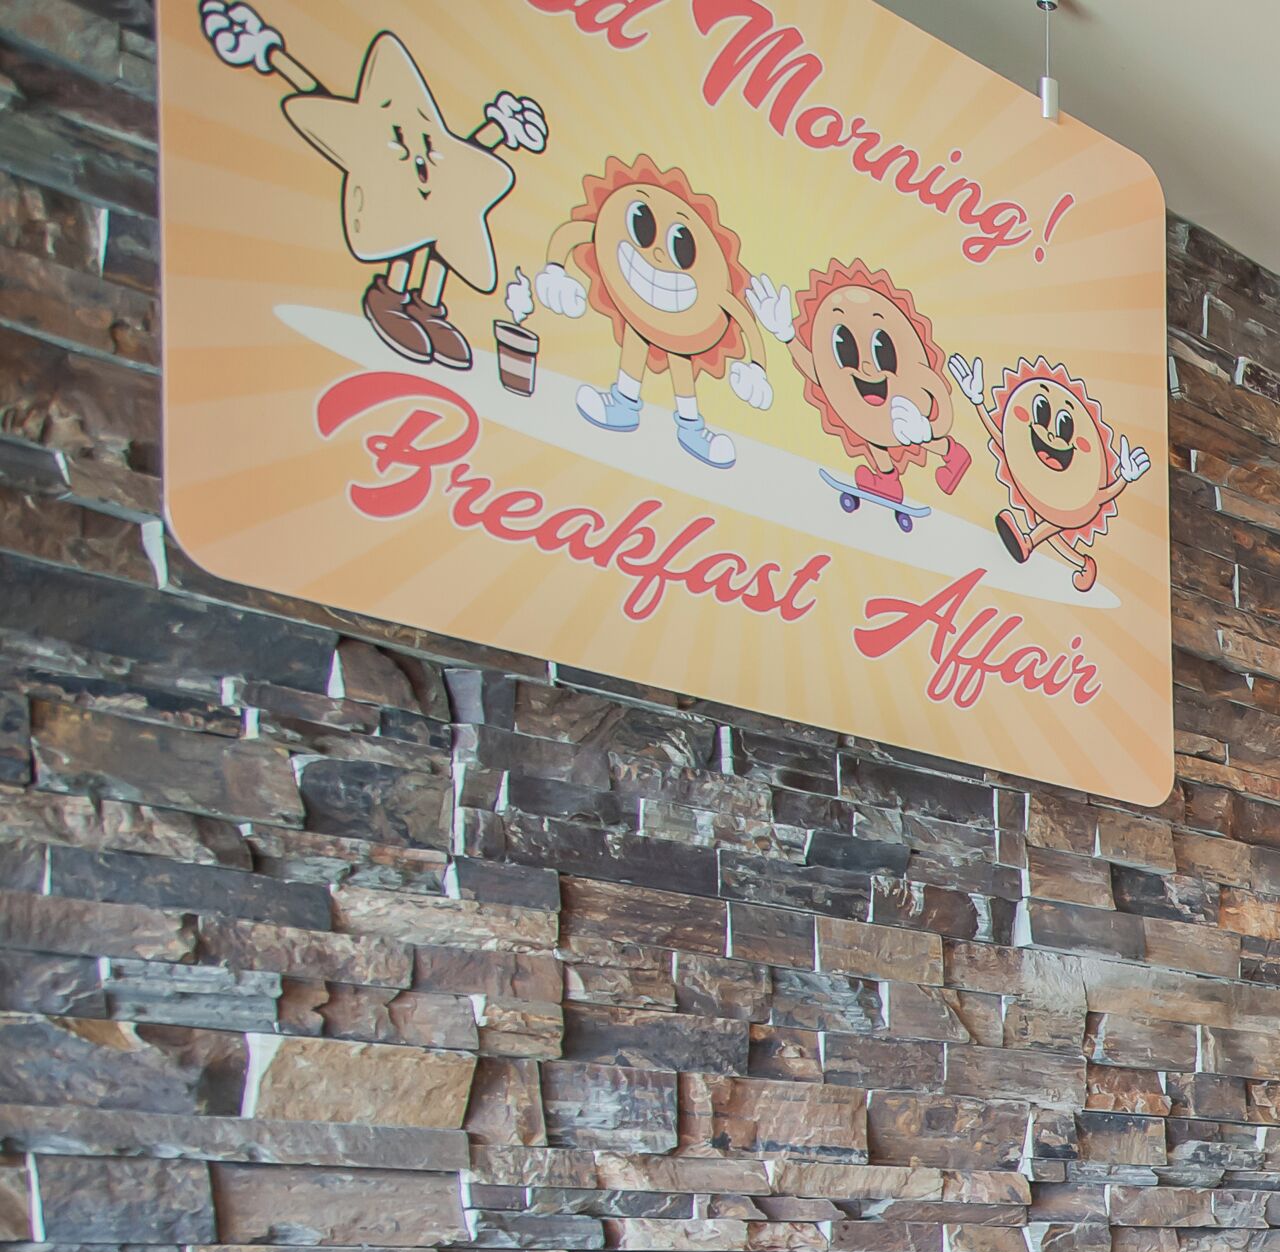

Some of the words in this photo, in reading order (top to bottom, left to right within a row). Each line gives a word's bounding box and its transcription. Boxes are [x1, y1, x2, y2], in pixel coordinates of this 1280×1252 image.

[690, 0, 1076, 265] Morning!
[316, 370, 831, 621] Breakfast
[853, 567, 1102, 707] Affair
